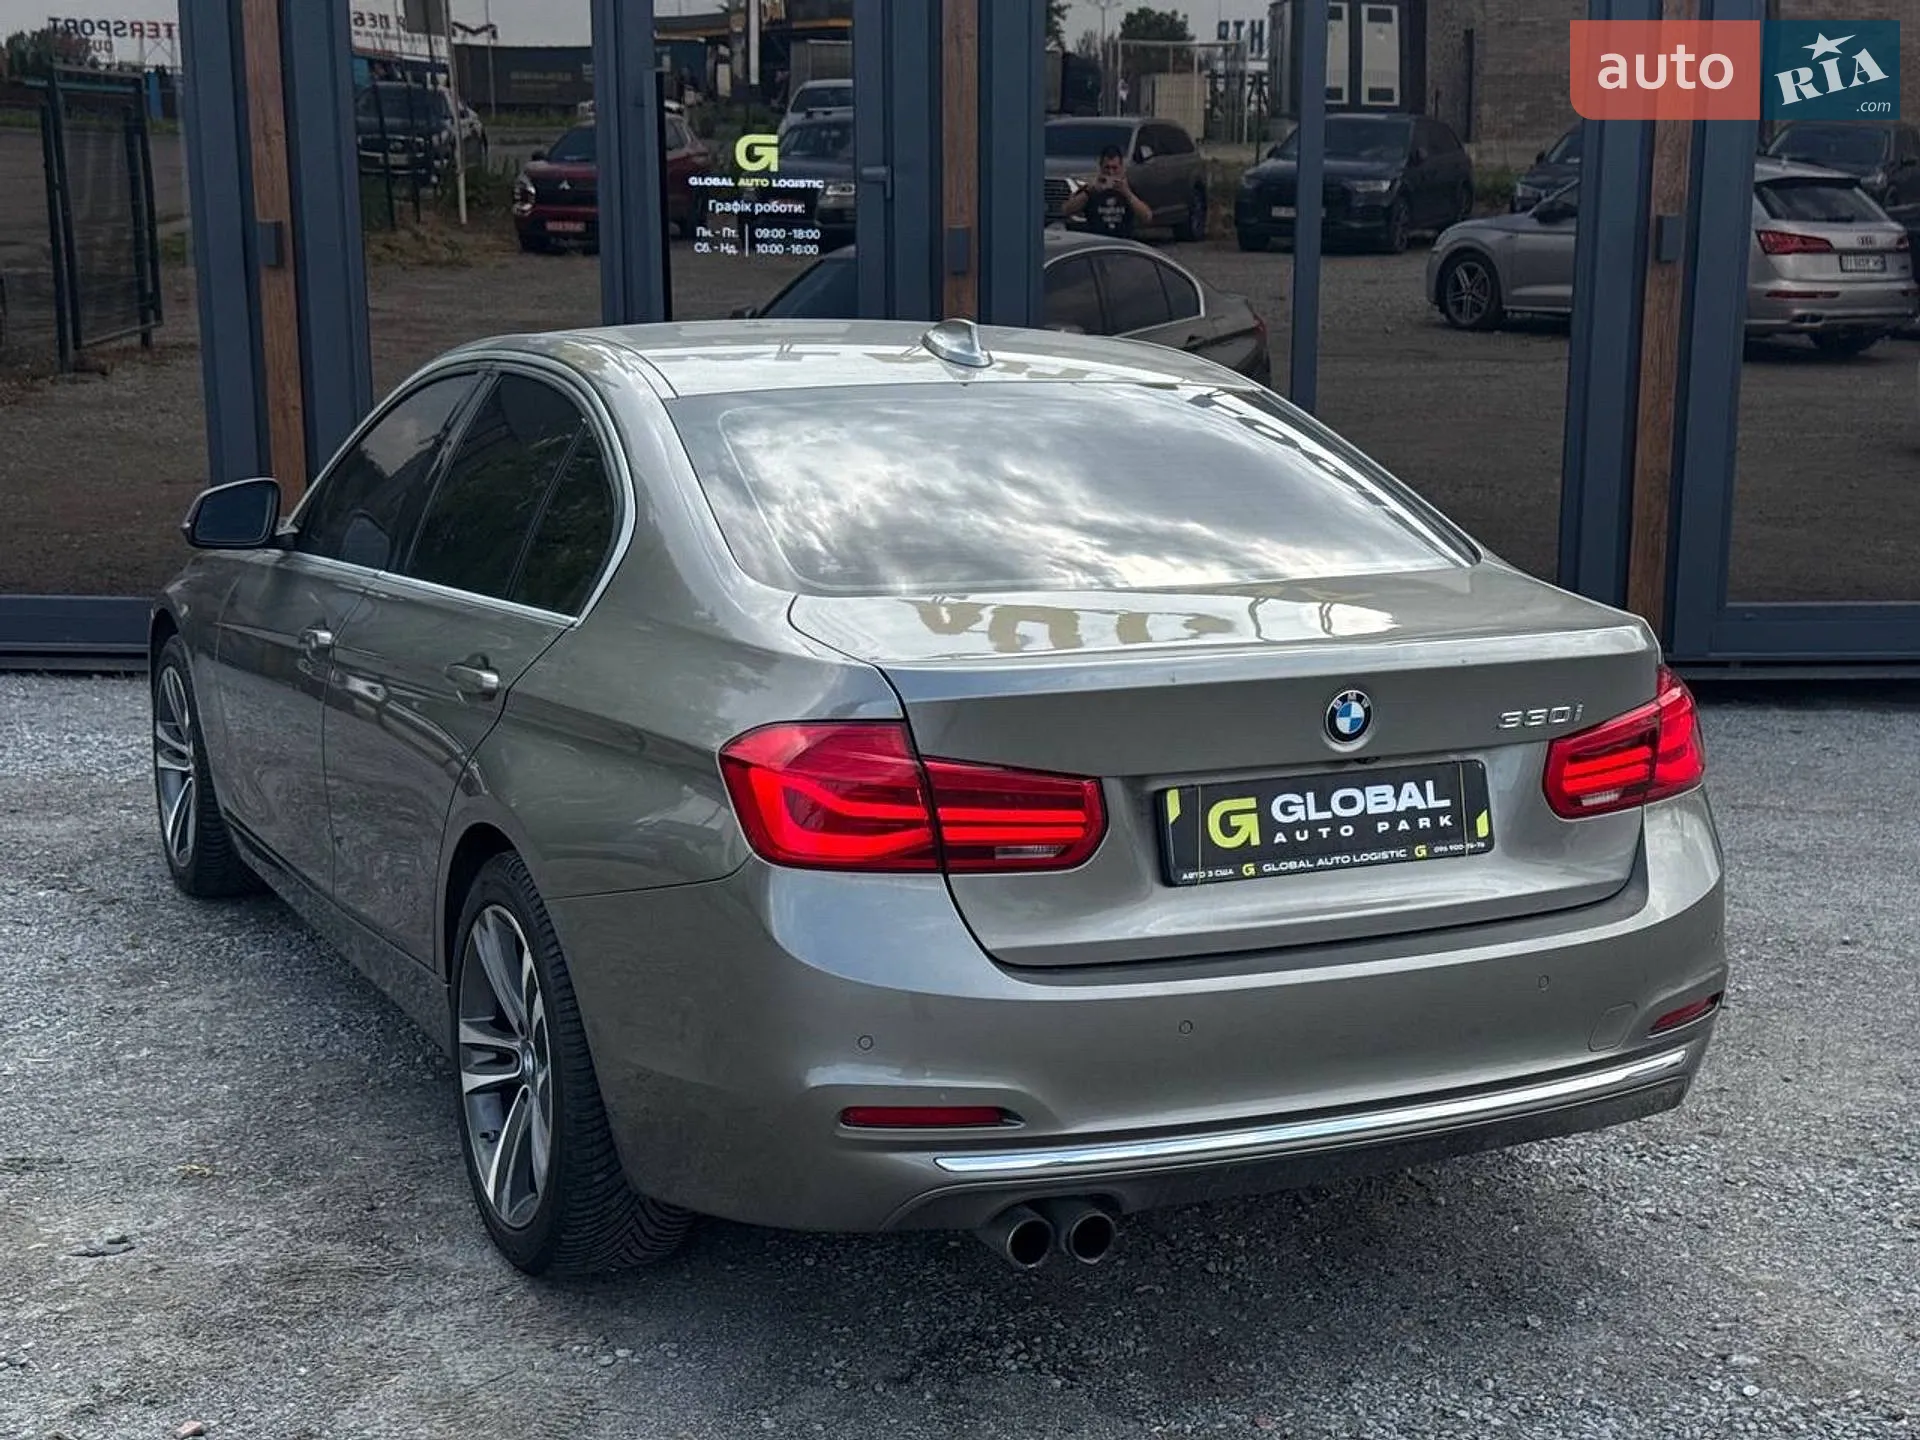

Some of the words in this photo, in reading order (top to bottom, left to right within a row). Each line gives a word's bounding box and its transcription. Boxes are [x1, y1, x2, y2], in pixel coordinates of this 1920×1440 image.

[688, 176, 735, 187] GLOBAL
[737, 178, 770, 188] AUTO
[772, 179, 825, 189] LOGISTIC
[708, 200, 751, 215] Графік
[754, 201, 806, 215] роботи:
[755, 243, 784, 254] 10:00
[1498, 703, 1585, 728] 330i
[1271, 780, 1451, 823] GLOBAL
[1273, 825, 1354, 844] AUTO
[1377, 814, 1453, 833] PARK
[1262, 859, 1314, 873] GLOBAL
[1316, 855, 1351, 867] AUTO
[1353, 849, 1408, 863] LOGISTIC
